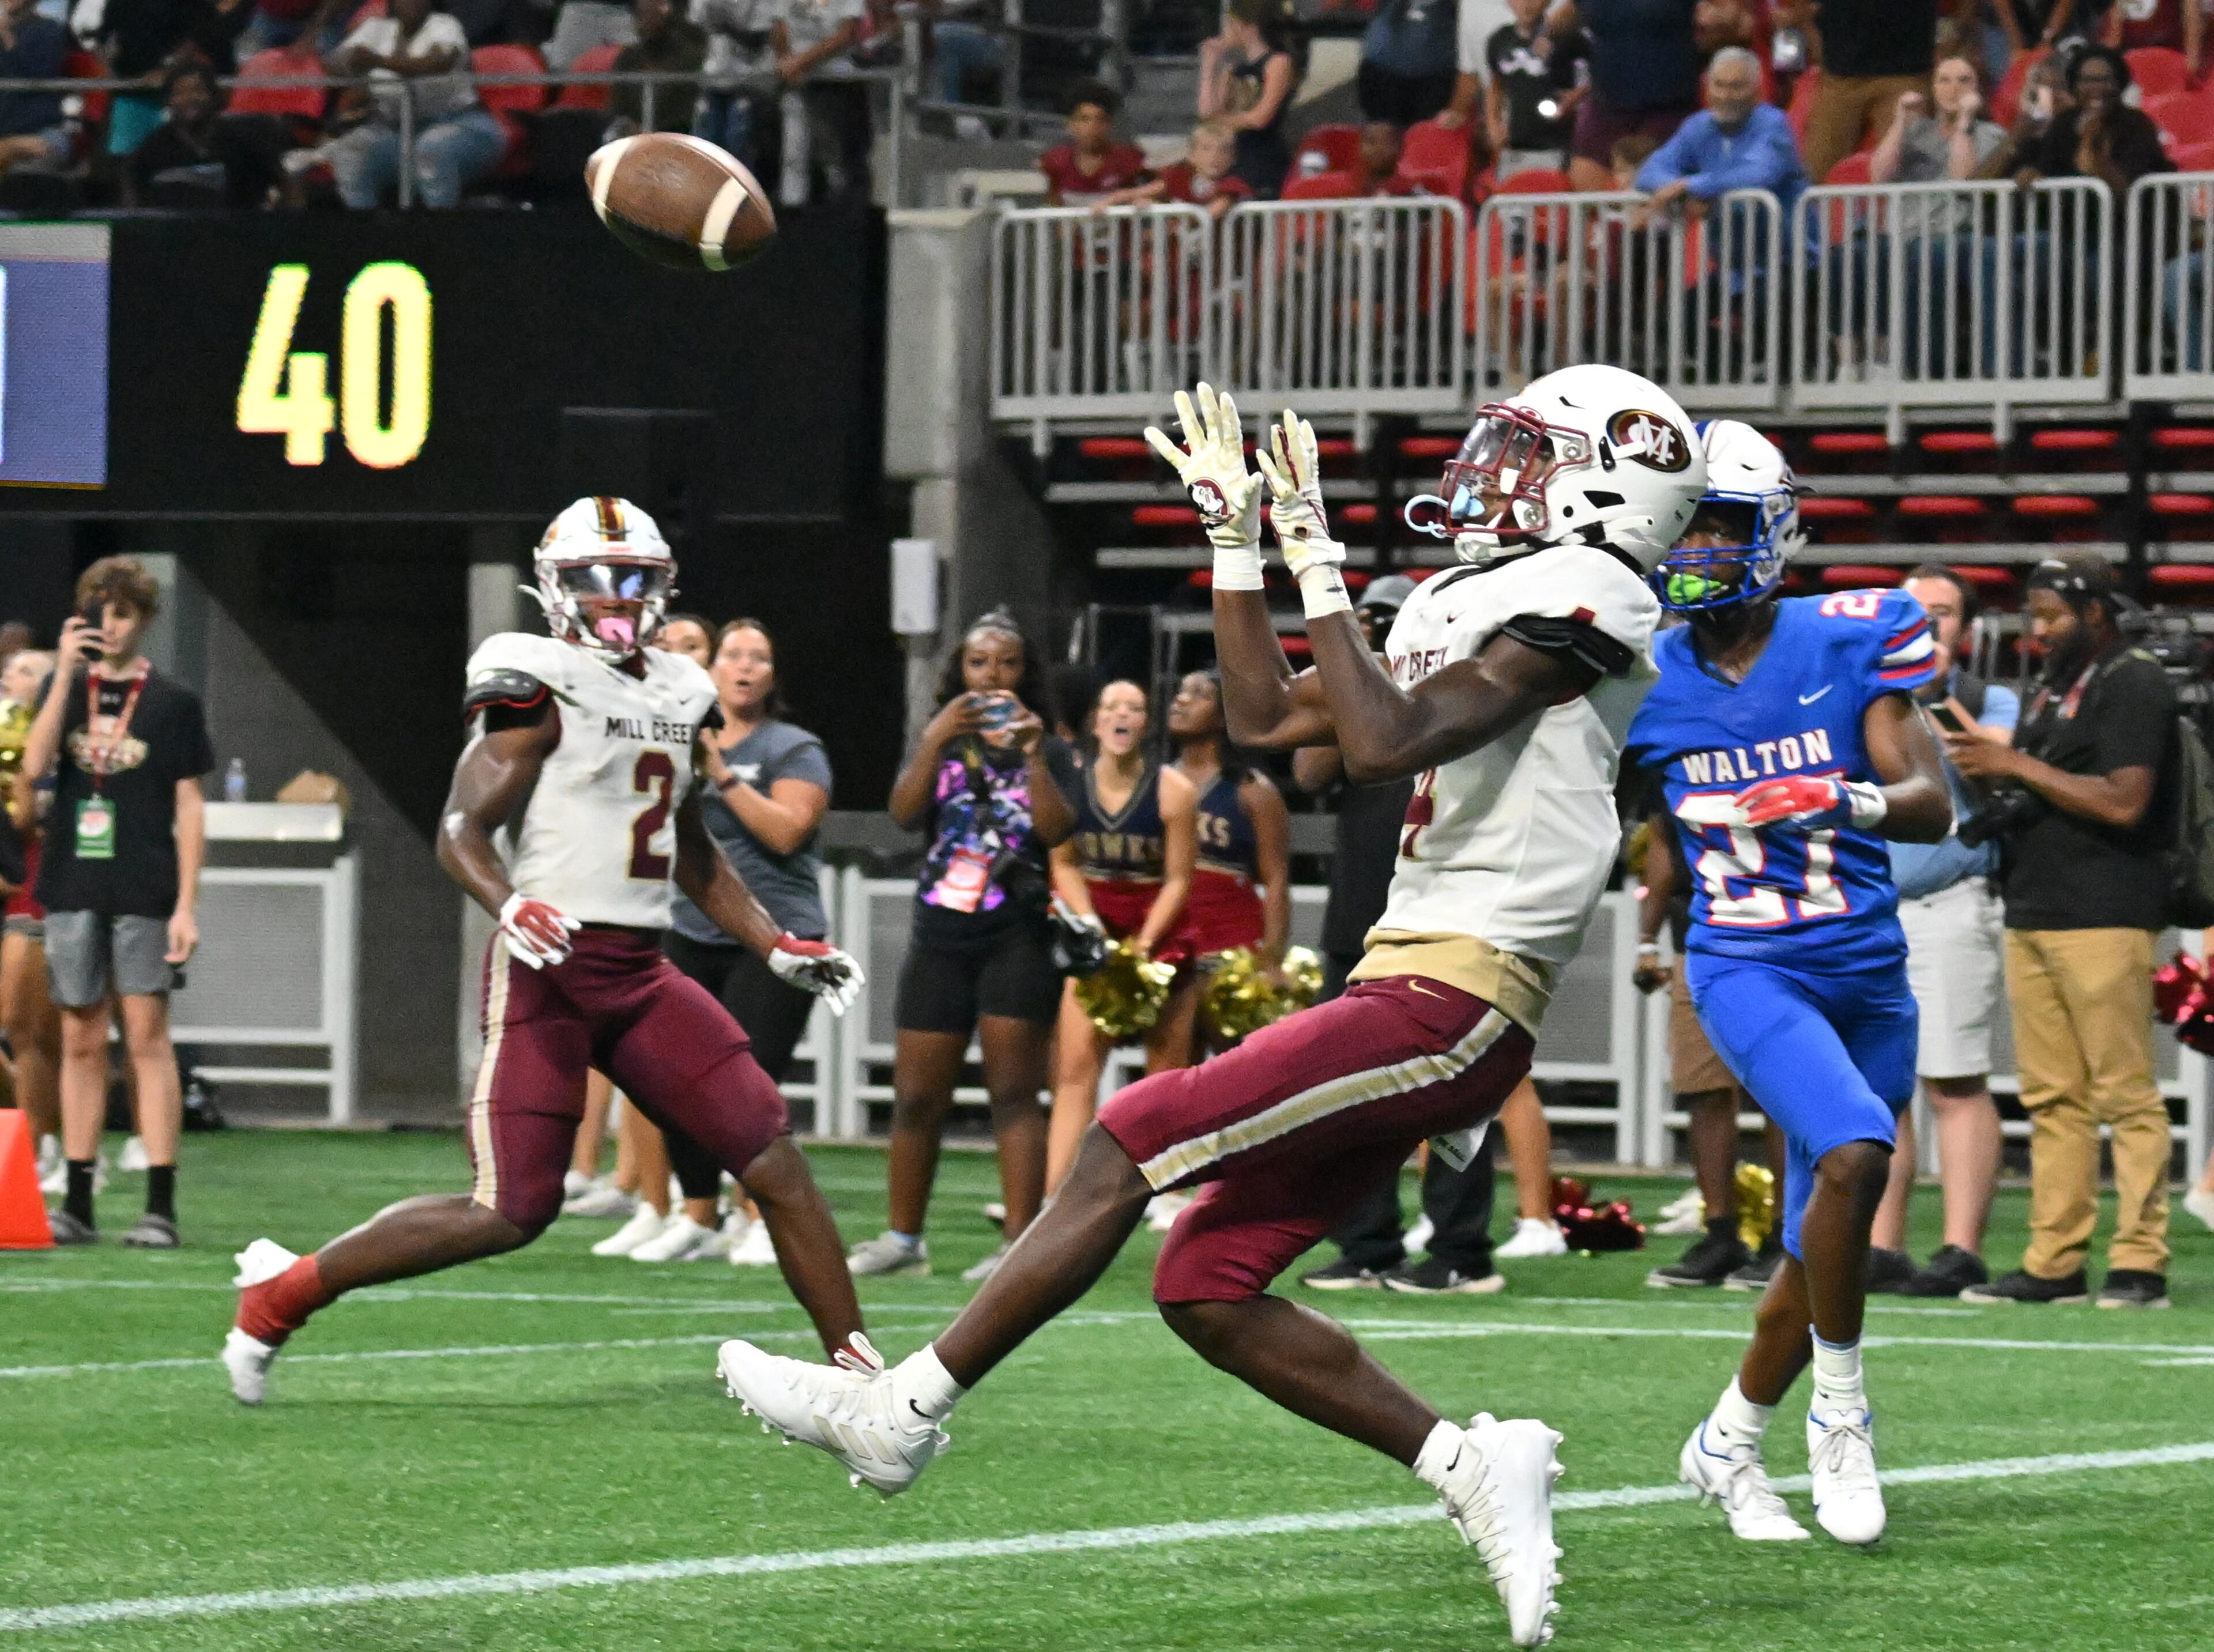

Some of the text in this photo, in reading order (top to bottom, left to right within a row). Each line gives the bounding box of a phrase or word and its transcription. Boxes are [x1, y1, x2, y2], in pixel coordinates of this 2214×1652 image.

[236, 261, 432, 468] 40
[605, 716, 645, 740] MILL
[1681, 729, 1832, 784] WALTON
[626, 748, 675, 883] 2
[1674, 768, 1851, 927] 21
